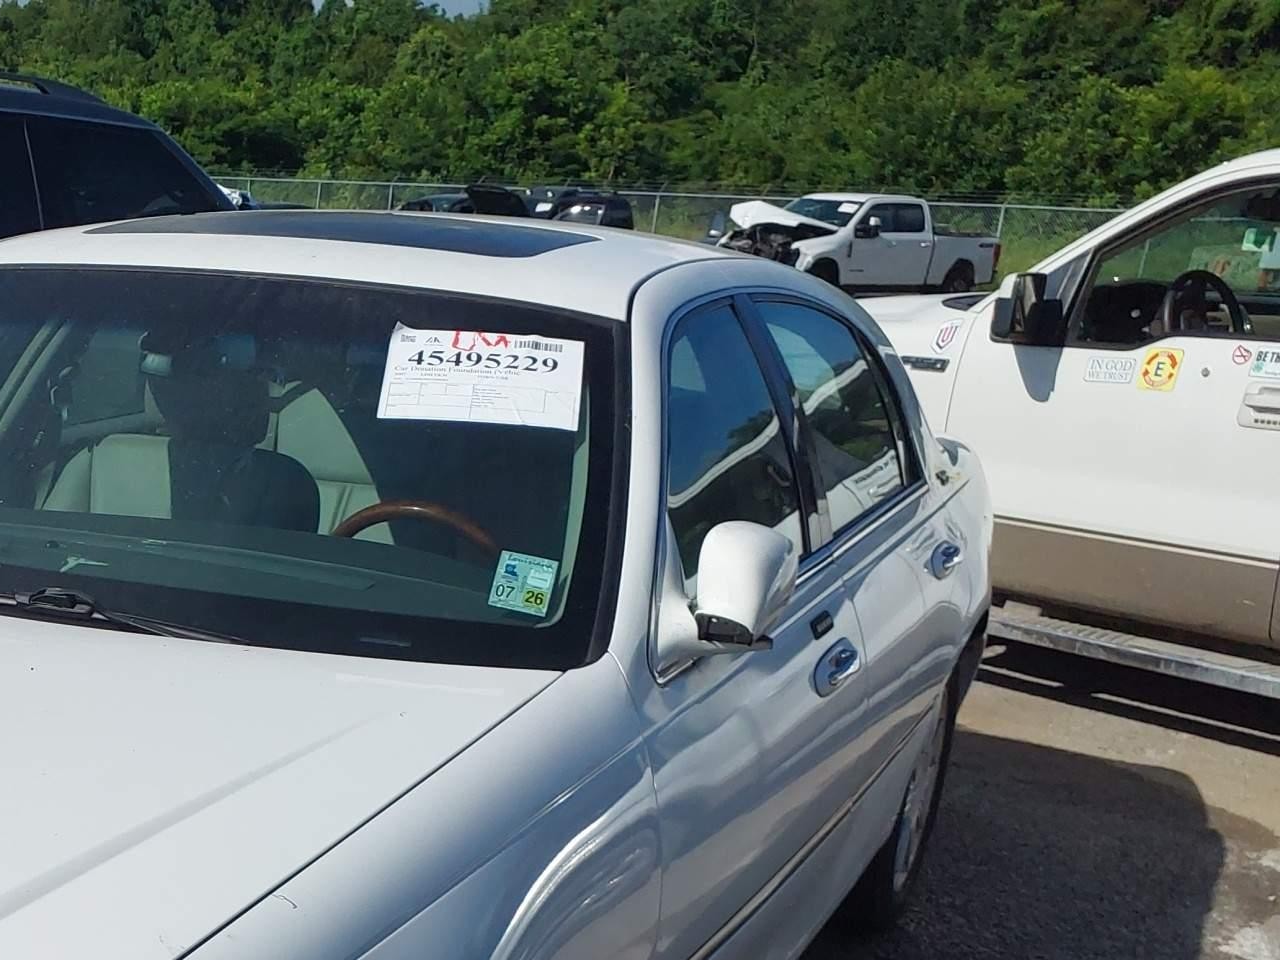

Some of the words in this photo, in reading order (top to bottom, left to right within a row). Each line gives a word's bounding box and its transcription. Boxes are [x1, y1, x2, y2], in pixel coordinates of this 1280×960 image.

[407, 350, 559, 373] 45495229
[1256, 350, 1269, 363] BE
[1090, 359, 1102, 370] IN
[1105, 359, 1133, 371] GOD
[1154, 361, 1167, 377] E
[1088, 370, 1103, 378] WE
[1103, 371, 1130, 380] TRUST
[495, 583, 515, 599] 07
[524, 590, 544, 606] 26
